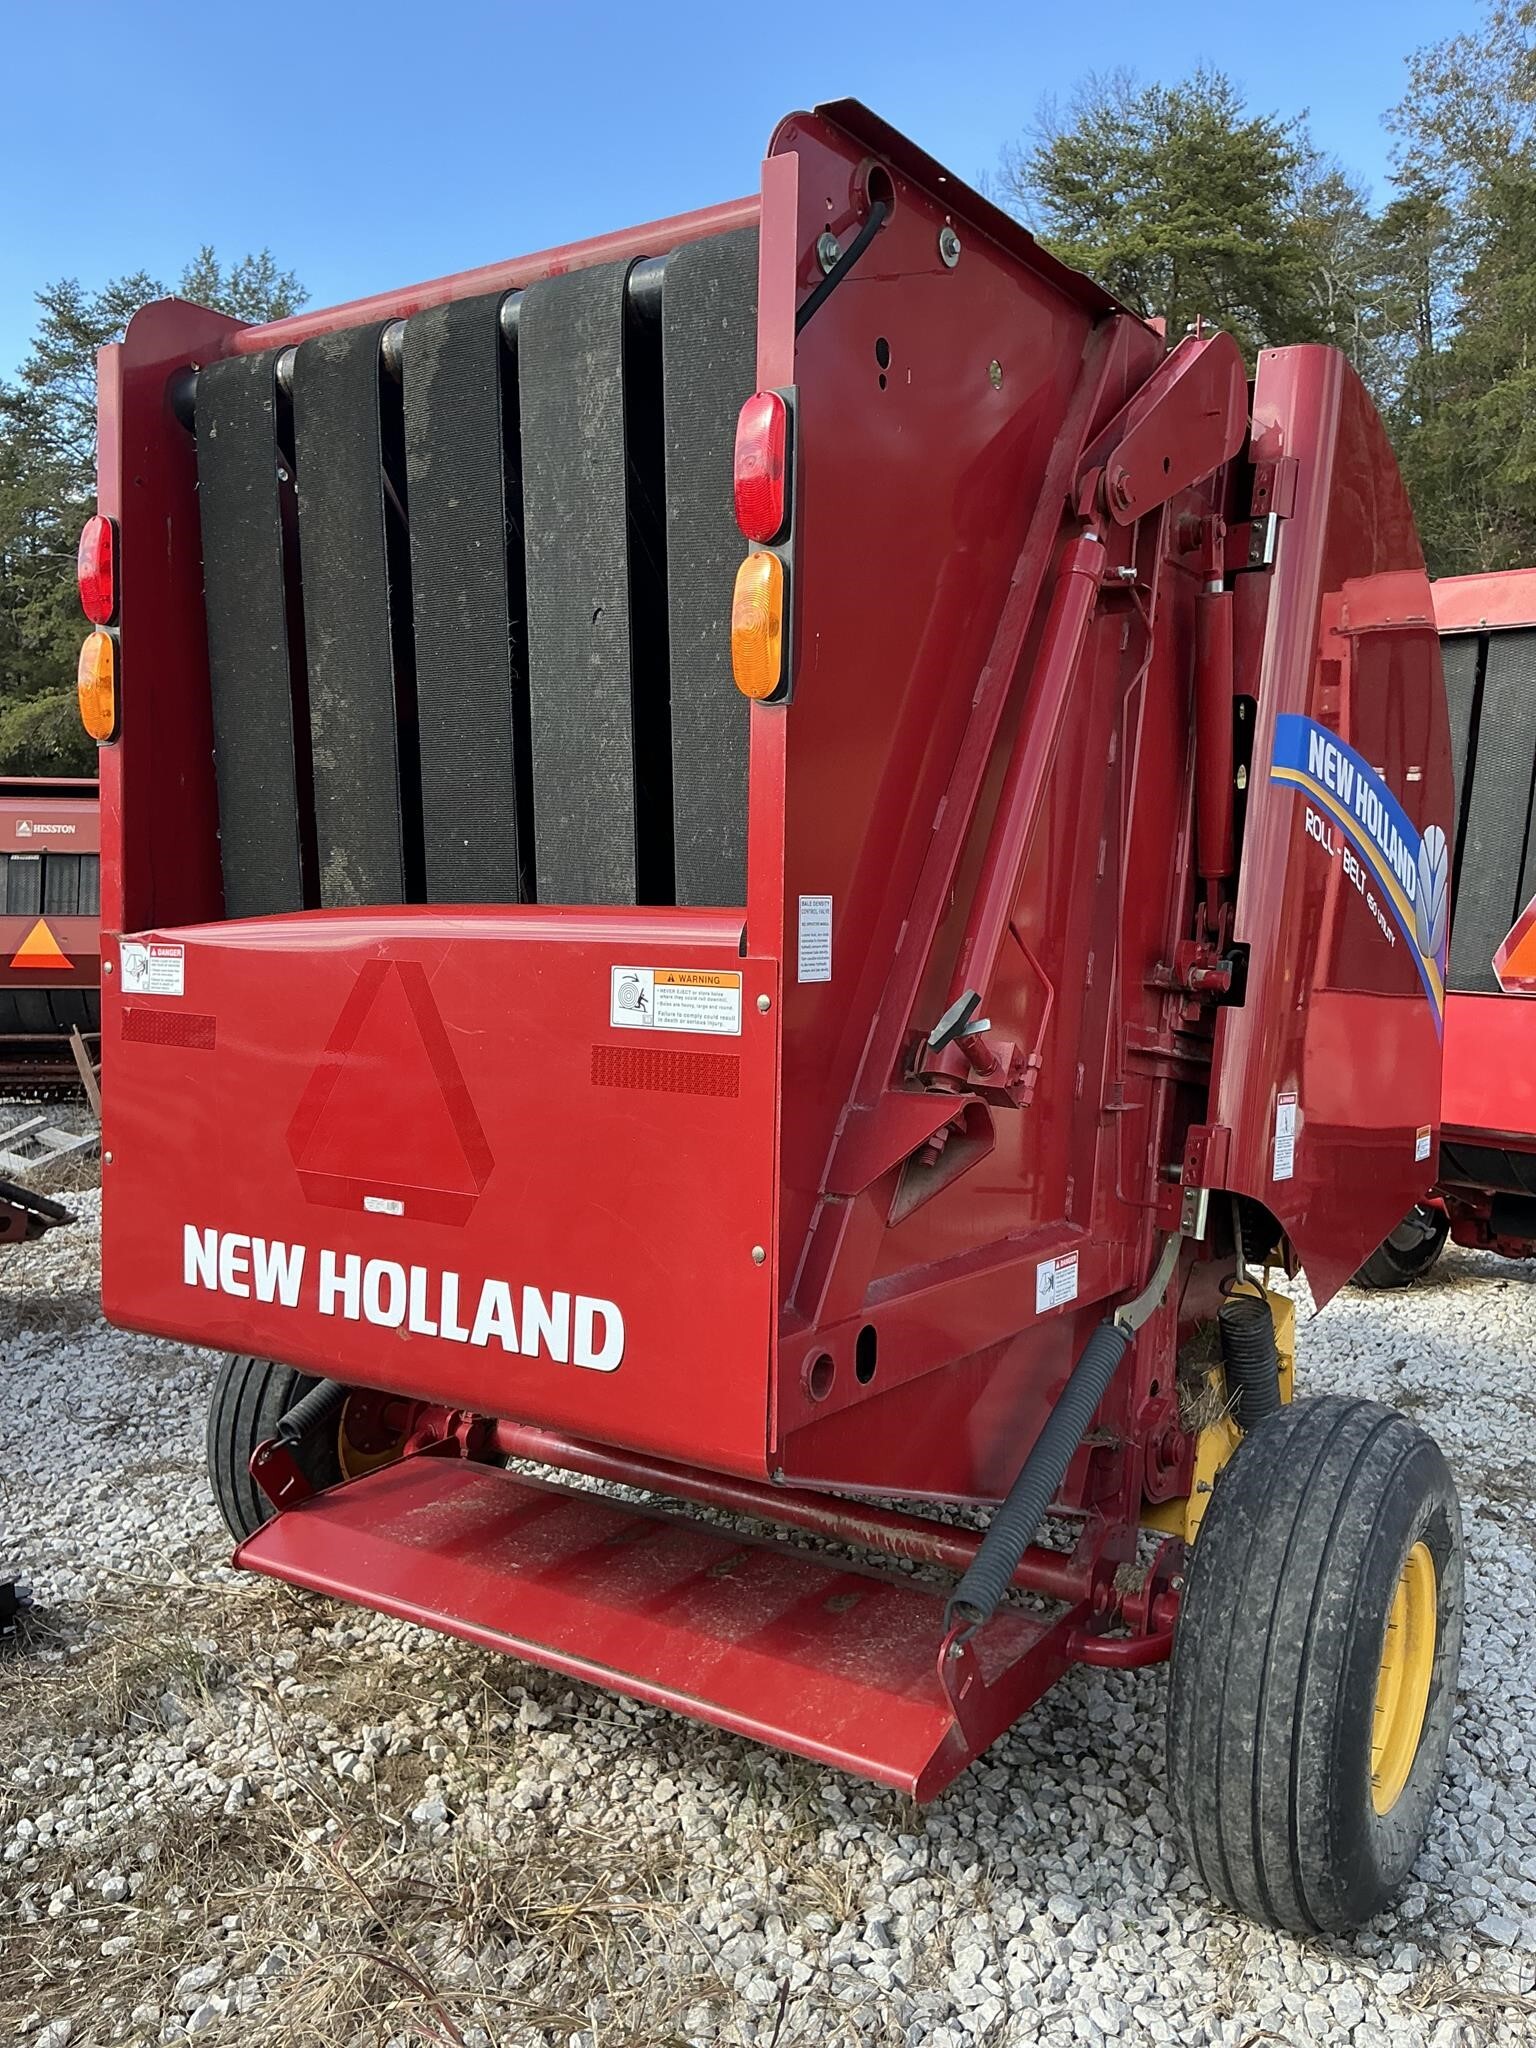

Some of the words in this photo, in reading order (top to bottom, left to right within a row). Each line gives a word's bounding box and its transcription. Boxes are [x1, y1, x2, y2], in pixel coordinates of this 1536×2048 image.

[33, 824, 76, 834] HESSTON
[1308, 729, 1354, 805] NEW
[1355, 775, 1417, 901] HOLLAND
[1305, 807, 1335, 856] ROLL
[1342, 847, 1367, 895] BELT
[1377, 908, 1396, 947] UTILITY
[158, 948, 182, 957] DANGER
[678, 974, 720, 984] WARNING
[184, 1224, 306, 1308] NEW
[319, 1249, 625, 1373] HOLLAND
